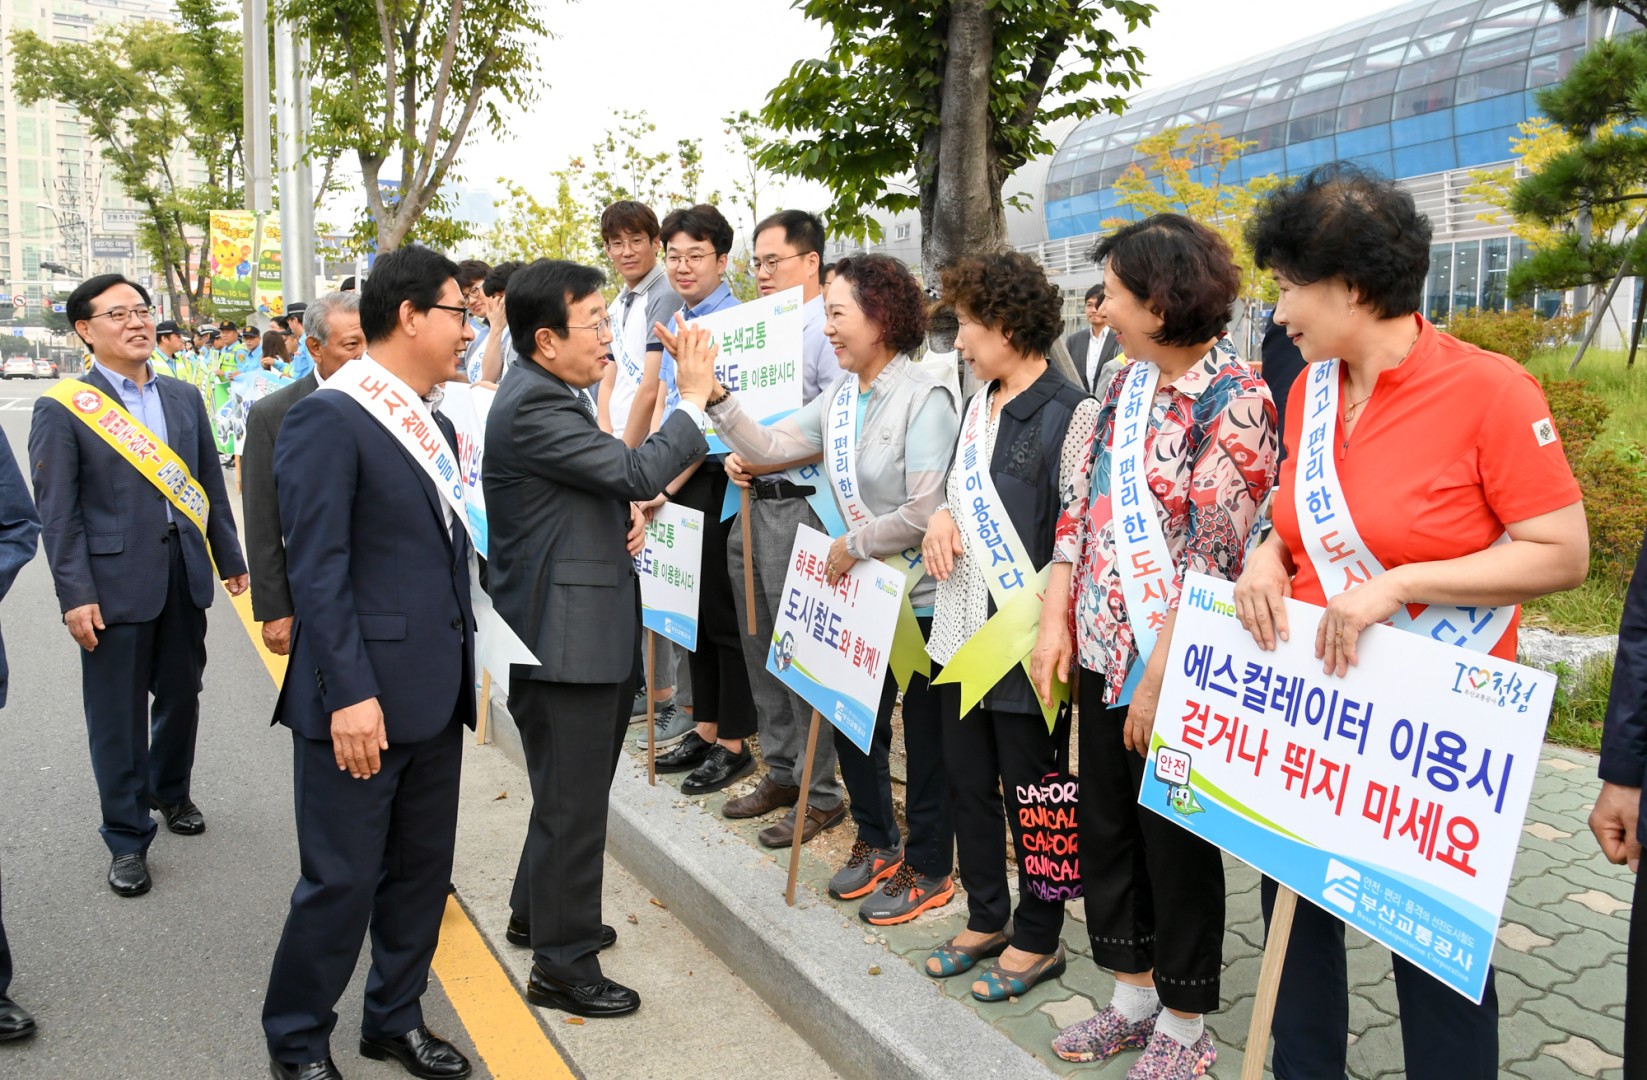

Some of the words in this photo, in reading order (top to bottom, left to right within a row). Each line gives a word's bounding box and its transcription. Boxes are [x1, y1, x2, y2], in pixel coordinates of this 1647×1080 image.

[722, 321, 766, 355] 녹색교통
[752, 360, 795, 388] 이용합시다
[359, 375, 454, 482] 도시철도를
[834, 435, 854, 499] 편리한
[847, 503, 868, 525] 도
[1119, 454, 1149, 544] 편리한
[1305, 422, 1336, 525] 편리한
[645, 519, 674, 548] 색교통
[965, 470, 1025, 590] 이용합시다
[1319, 530, 1373, 591] 도시
[661, 563, 694, 592] 이용합시다
[796, 550, 828, 588] 하루의
[785, 587, 850, 658] 도시철도와
[852, 637, 880, 679] 함께!
[1493, 671, 1537, 713] 청렴
[1184, 643, 1374, 755] 에스컬레이터
[1390, 718, 1514, 815] 이용시
[1159, 753, 1187, 778] 안전
[1180, 699, 1269, 777] 걷거나
[1280, 741, 1350, 816] 뛰지
[1362, 780, 1480, 877] 마세요
[1357, 910, 1376, 927] Busan
[1378, 922, 1426, 956] Transportation
[1427, 952, 1470, 982] Corporation
[1360, 893, 1473, 972] 부산교통공사
[1432, 915, 1476, 948] 선진도시철도
